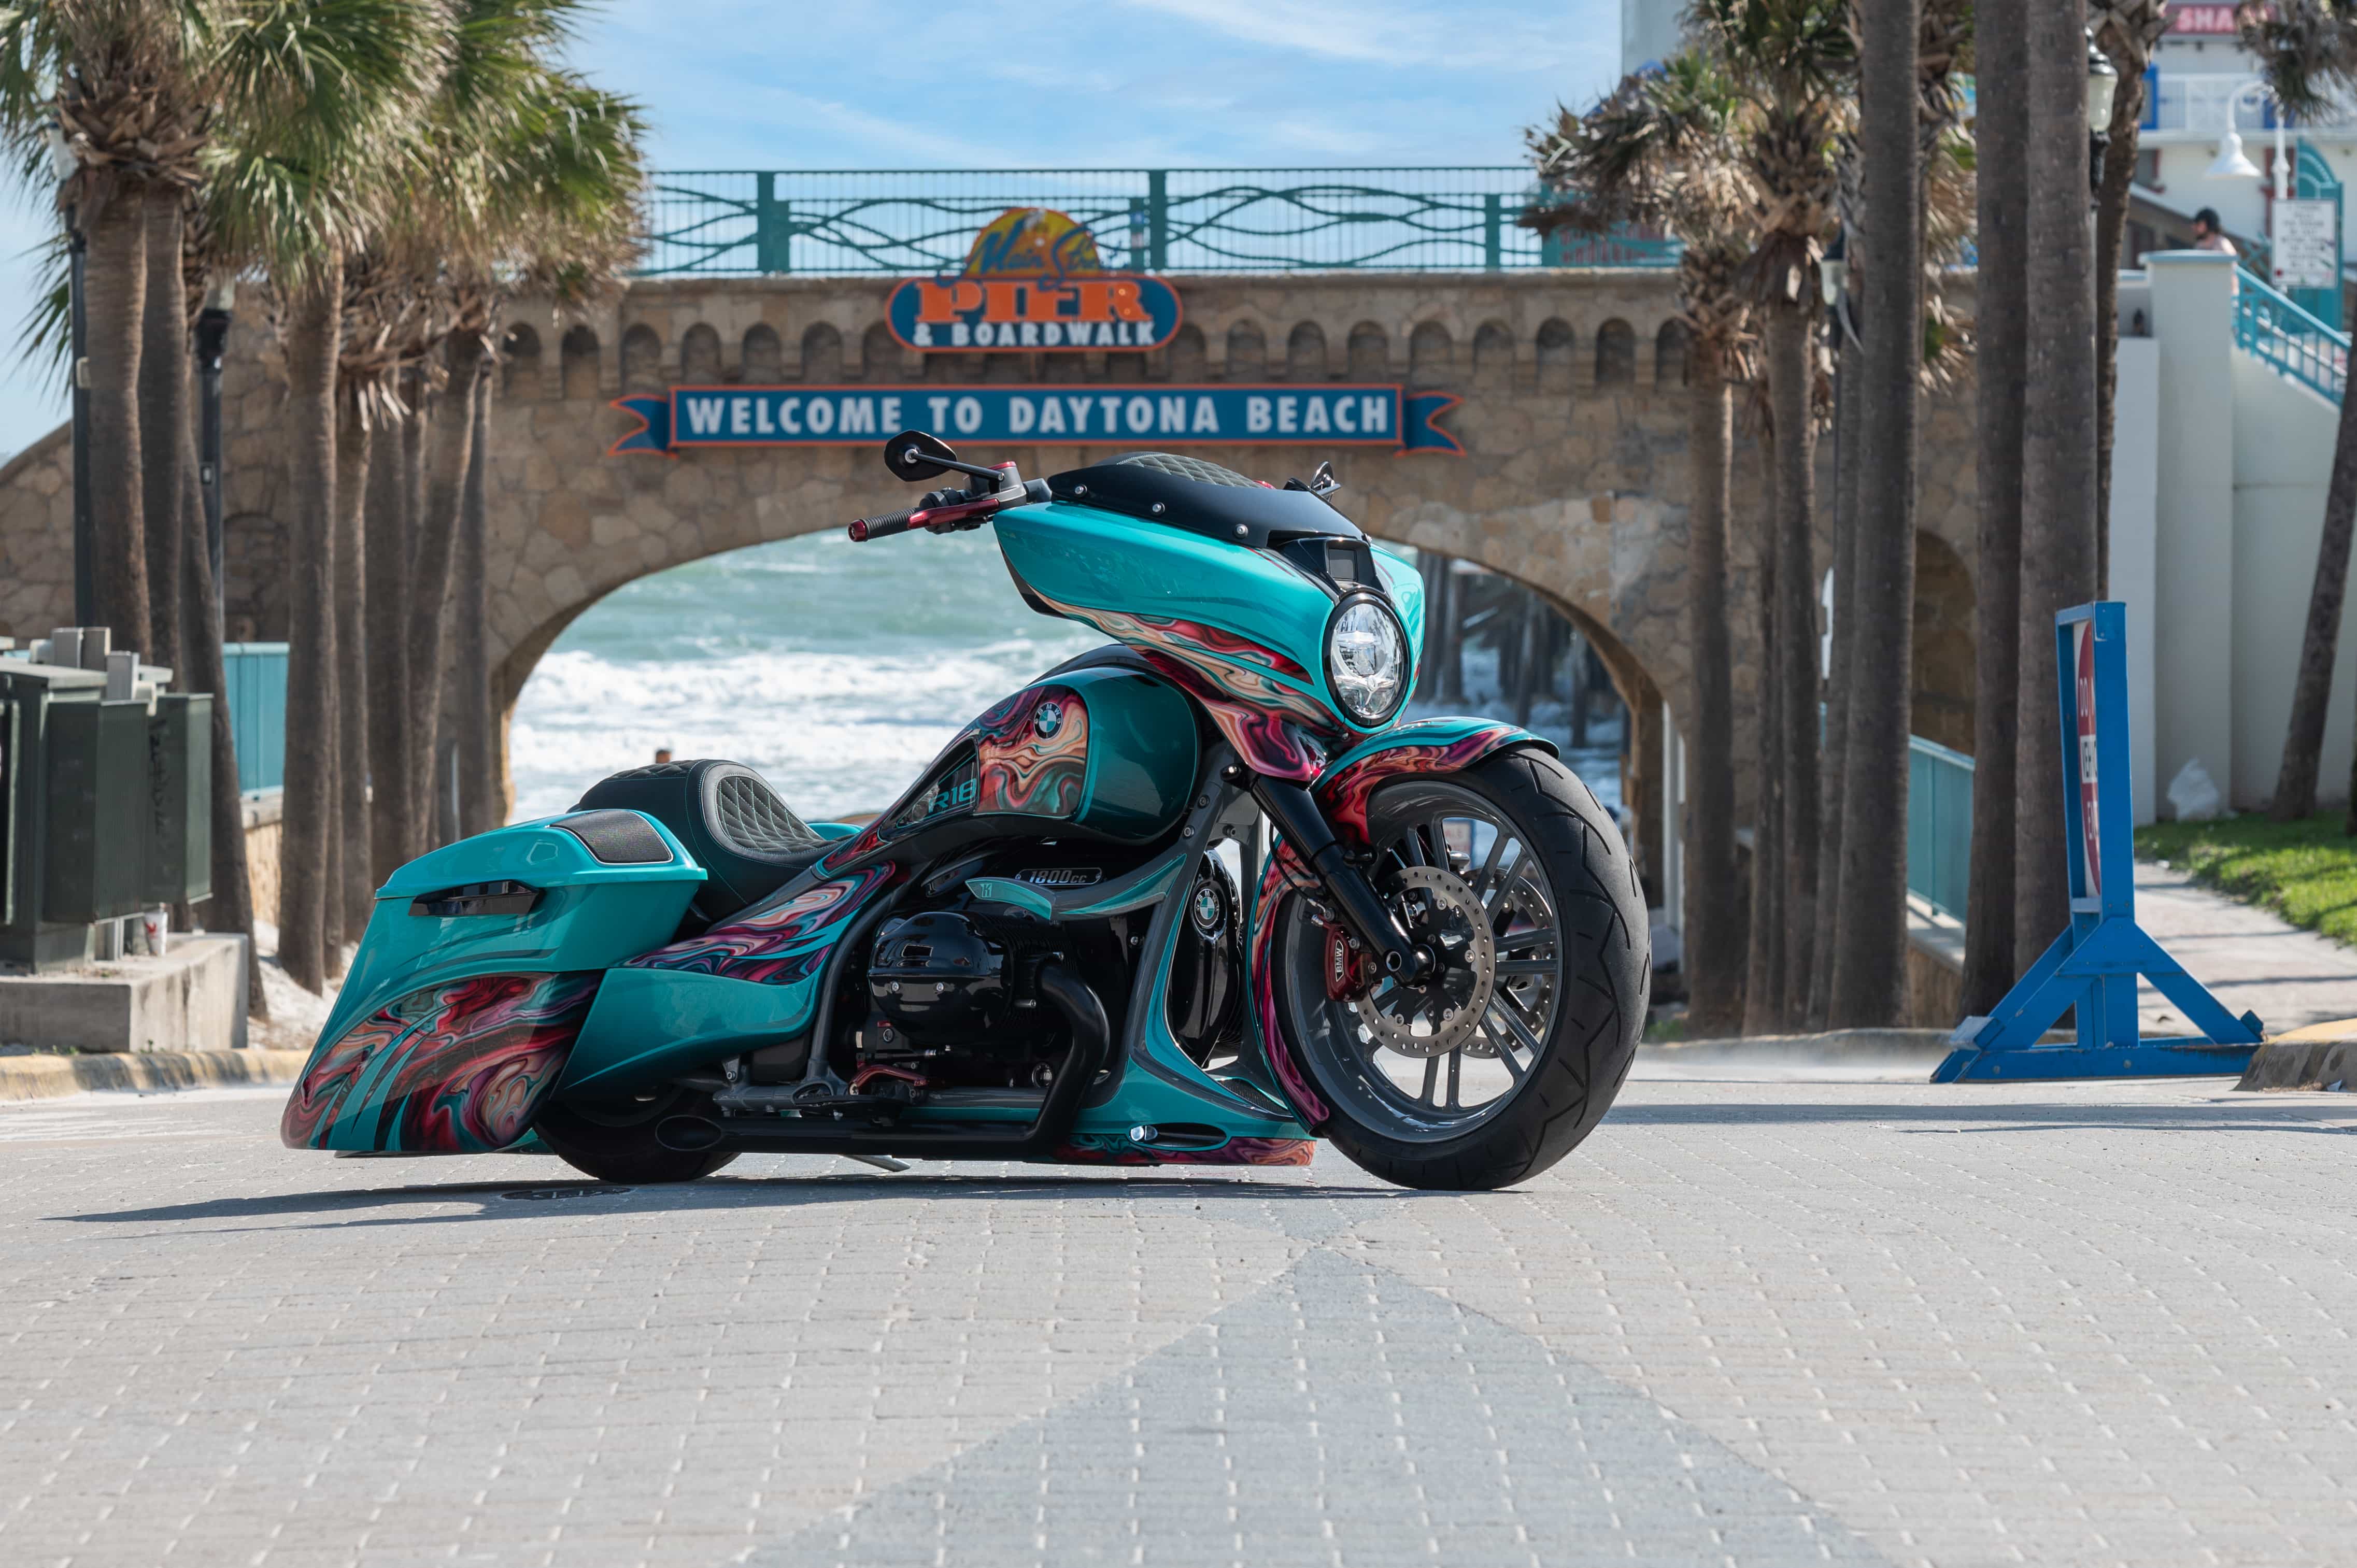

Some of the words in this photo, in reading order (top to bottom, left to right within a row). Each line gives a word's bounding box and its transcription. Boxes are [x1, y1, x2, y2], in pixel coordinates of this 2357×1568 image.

[915, 281, 1153, 322] PIER
[913, 323, 933, 347] &
[952, 321, 1156, 347] BOARDWALK
[686, 397, 901, 434] WELCOME
[928, 397, 983, 434] TO
[1009, 396, 1219, 433] DAYTONA
[1246, 396, 1388, 433] BEACH
[1037, 704, 1060, 716] BMW
[928, 778, 977, 813] R18
[1029, 870, 1087, 883] 1800cc
[1198, 890, 1217, 903] BMW
